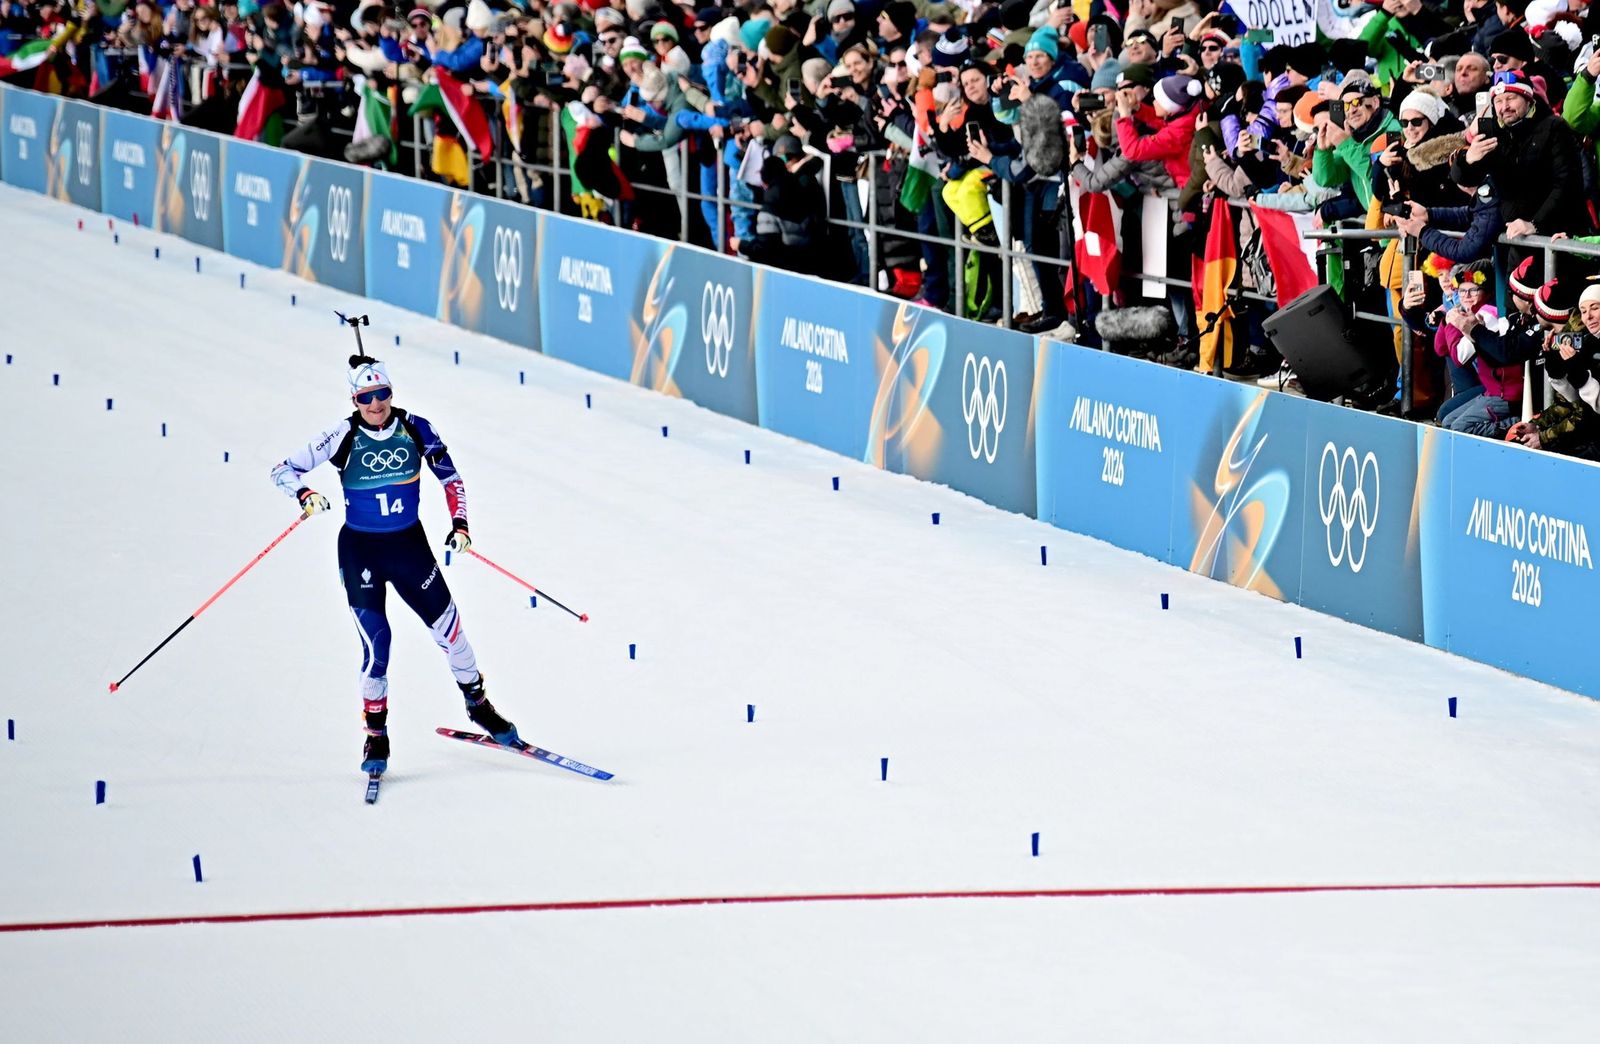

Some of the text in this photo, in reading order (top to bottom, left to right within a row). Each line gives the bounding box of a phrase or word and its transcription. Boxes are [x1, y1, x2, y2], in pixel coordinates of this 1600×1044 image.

[780, 316, 849, 365] MILANO CORTINA
[805, 359, 823, 395] 2026
[315, 433, 336, 452] CRAFT
[1069, 395, 1162, 453] MILANO CORTINA
[1101, 446, 1125, 487] 2026
[375, 493, 404, 516] 14
[1466, 496, 1594, 570] MILANO CORTINA
[421, 565, 440, 590] CRAFT
[1511, 558, 1541, 608] 2026
